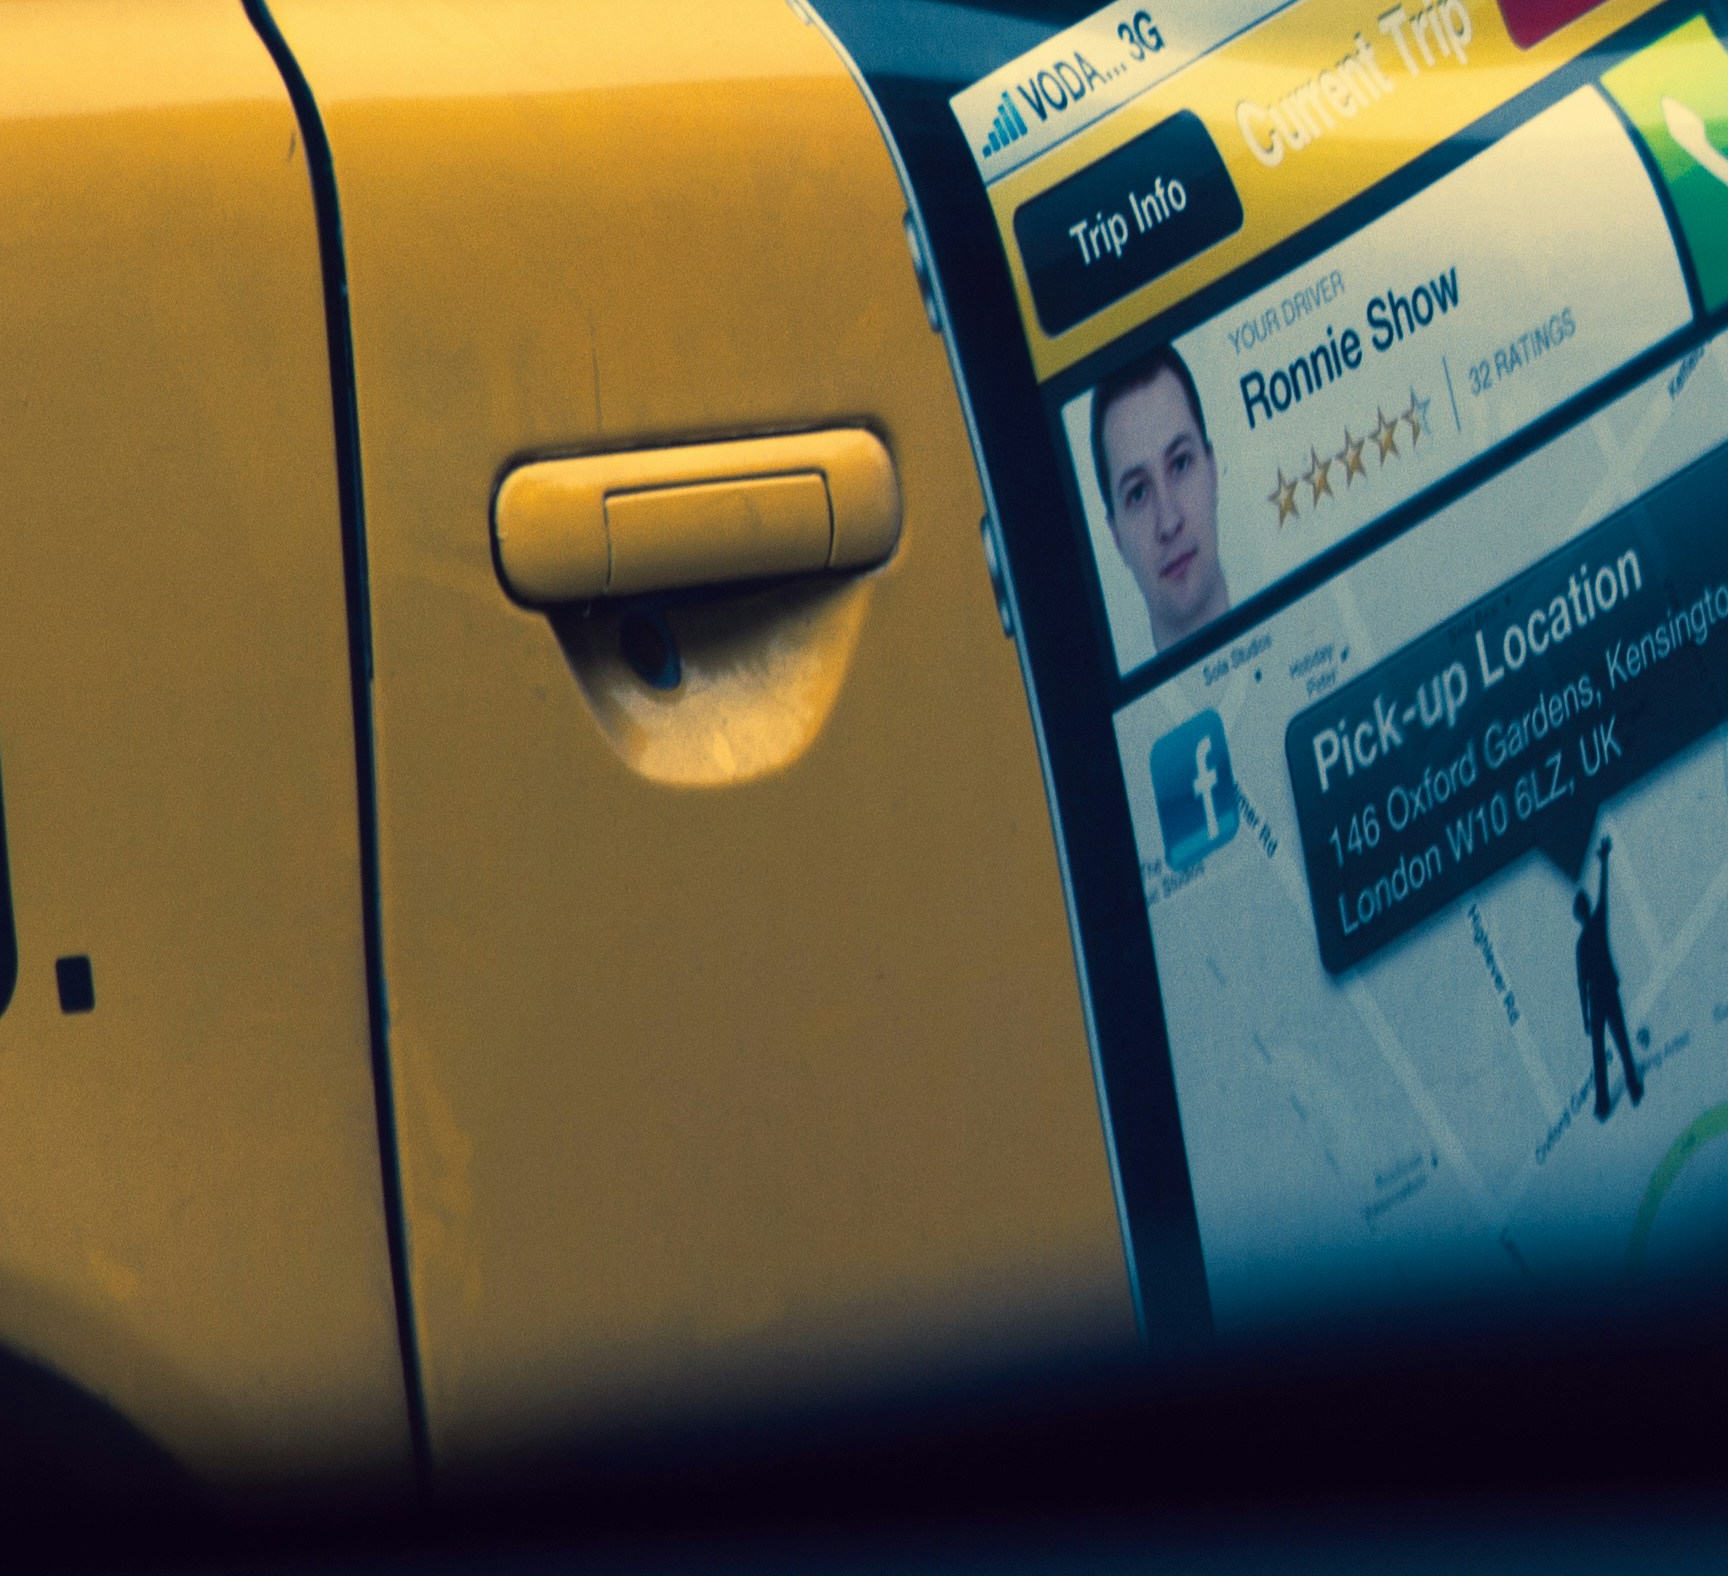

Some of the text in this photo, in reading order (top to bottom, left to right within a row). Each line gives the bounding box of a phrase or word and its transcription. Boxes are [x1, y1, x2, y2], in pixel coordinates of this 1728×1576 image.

[1117, 10, 1164, 61] 3G
[1236, 33, 1374, 168] Current
[1070, 176, 1188, 267] Trip Info
[1226, 271, 1346, 354] YOUR DRIVER
[1240, 268, 1461, 428] Ronnie Show
[1469, 308, 1577, 394] 32 RATINGS
[1311, 668, 1468, 792] Pick-up
[1475, 546, 1643, 688] Location
[1329, 805, 1380, 867] 146
[1388, 742, 1478, 832] Oxford
[1483, 675, 1603, 770] Gardens,
[1340, 713, 1622, 935] London W10 6LZ, UK
